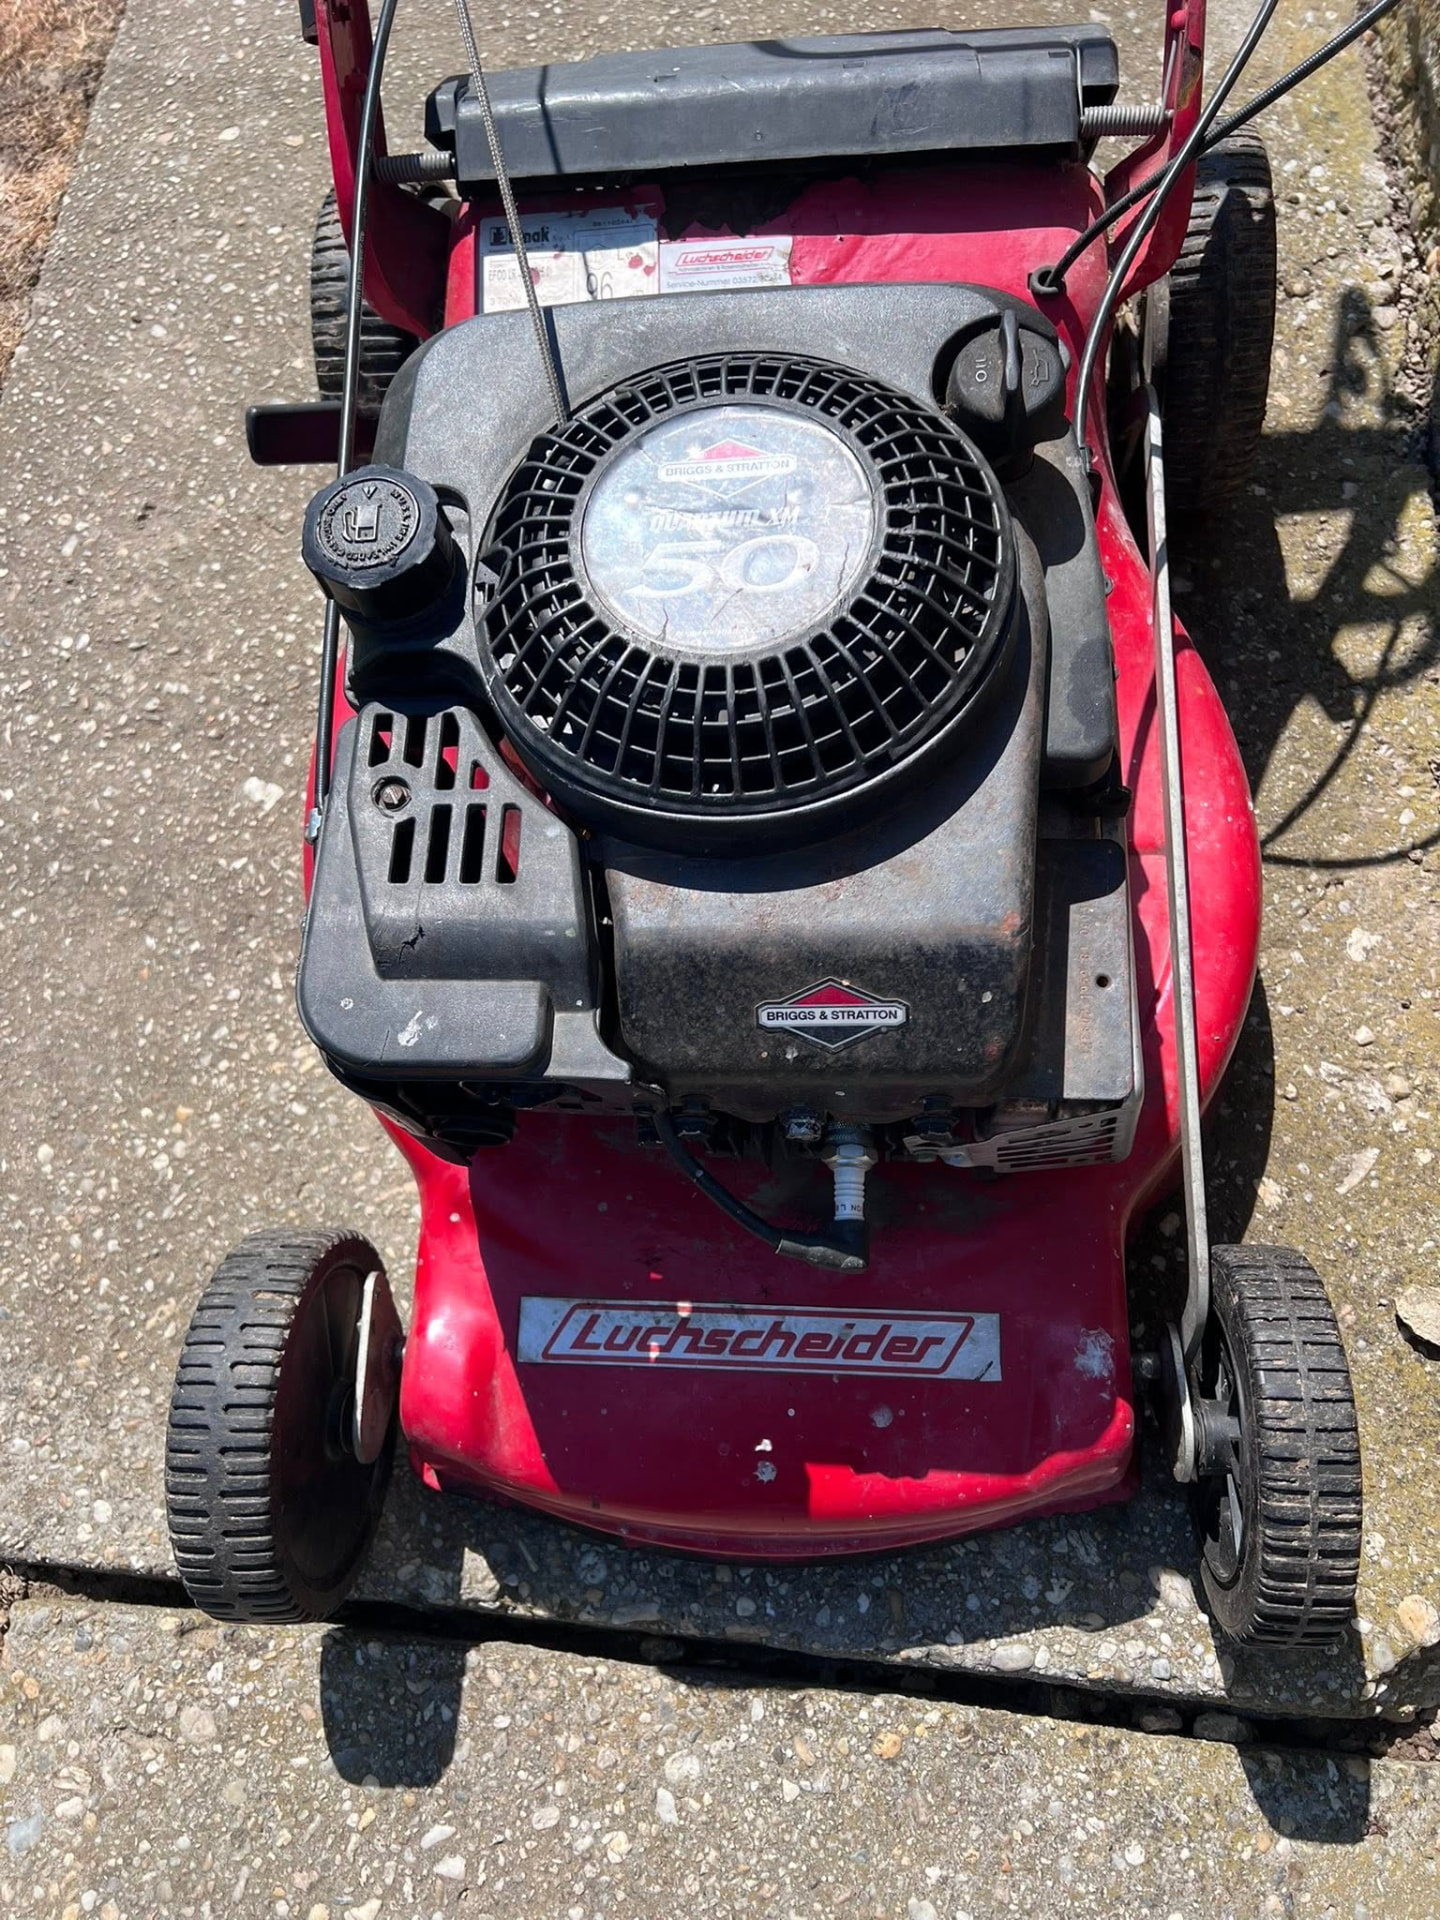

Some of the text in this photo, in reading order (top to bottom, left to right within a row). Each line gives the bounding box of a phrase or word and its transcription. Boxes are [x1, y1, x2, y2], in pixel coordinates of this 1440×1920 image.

[682, 249, 769, 265] Luchscheider
[975, 355, 988, 383] OIL
[665, 459, 791, 477] BRIGGS & STRATTON
[624, 534, 820, 597] 50
[766, 1009, 898, 1021] BRIGGS & STRATTON
[569, 1313, 946, 1363] Luchscheider
